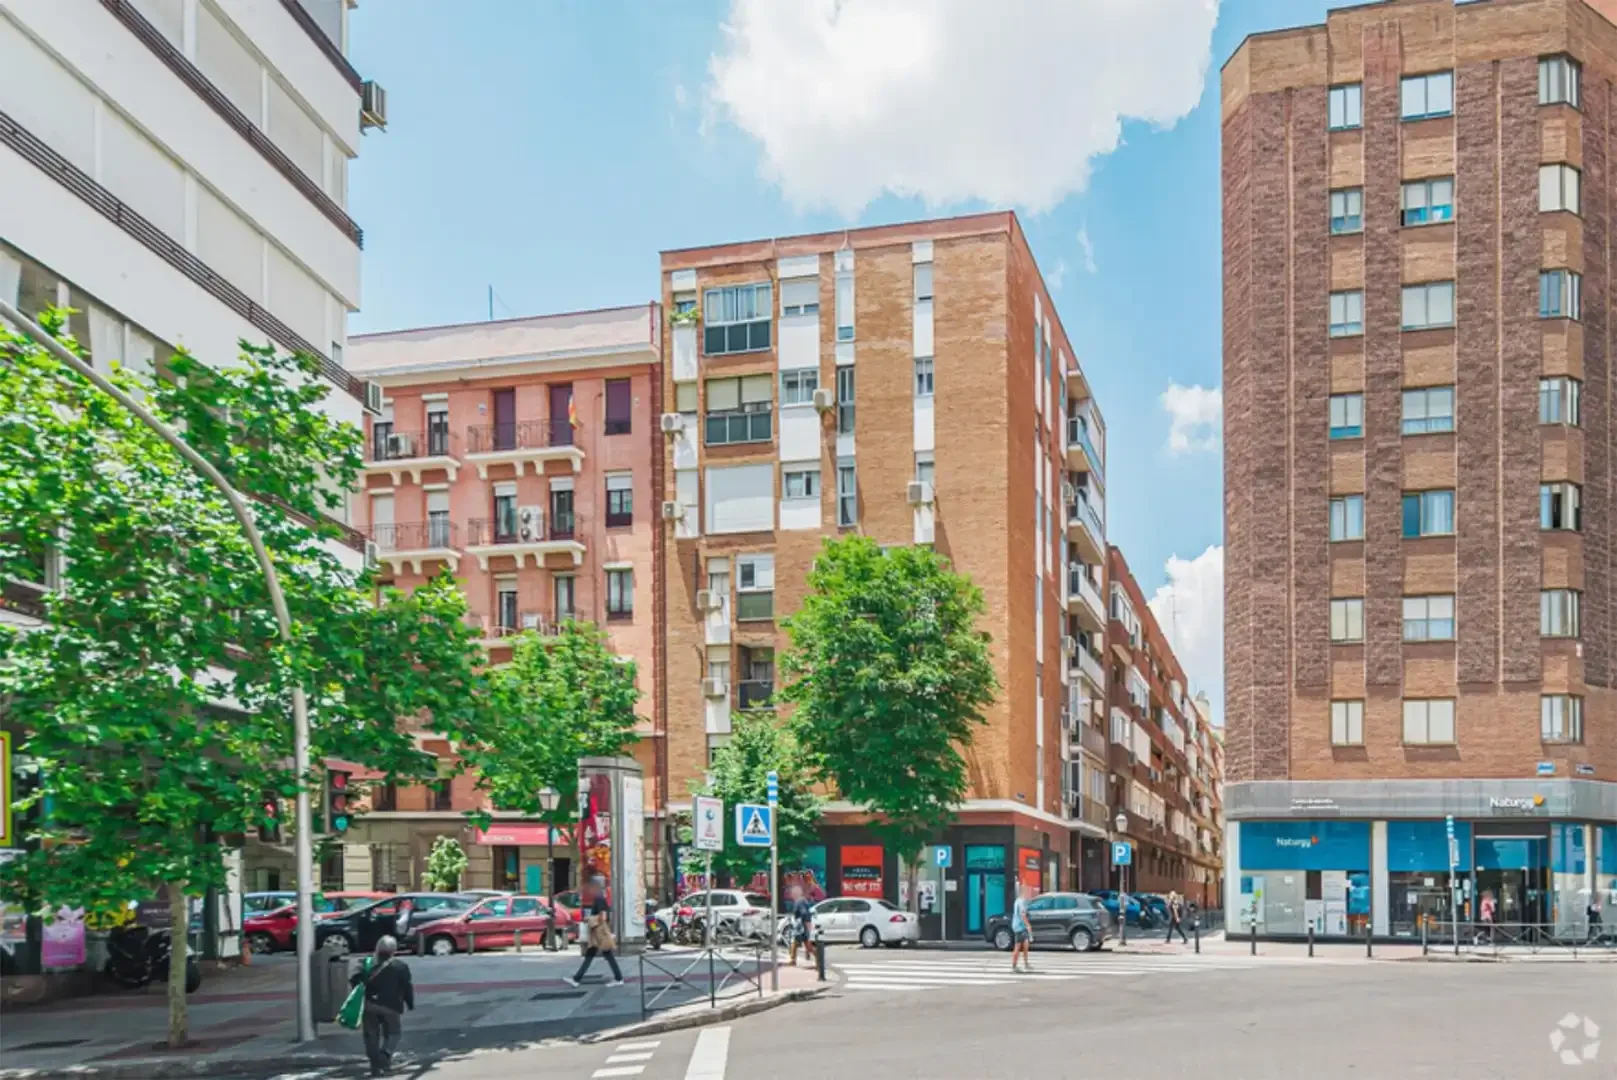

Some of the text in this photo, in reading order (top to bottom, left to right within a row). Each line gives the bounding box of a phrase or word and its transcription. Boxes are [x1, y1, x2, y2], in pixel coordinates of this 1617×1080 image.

[1490, 796, 1535, 811] Naturgy
[1276, 836, 1311, 848] Naturgy
[937, 848, 947, 865] P
[1115, 845, 1126, 862] P
